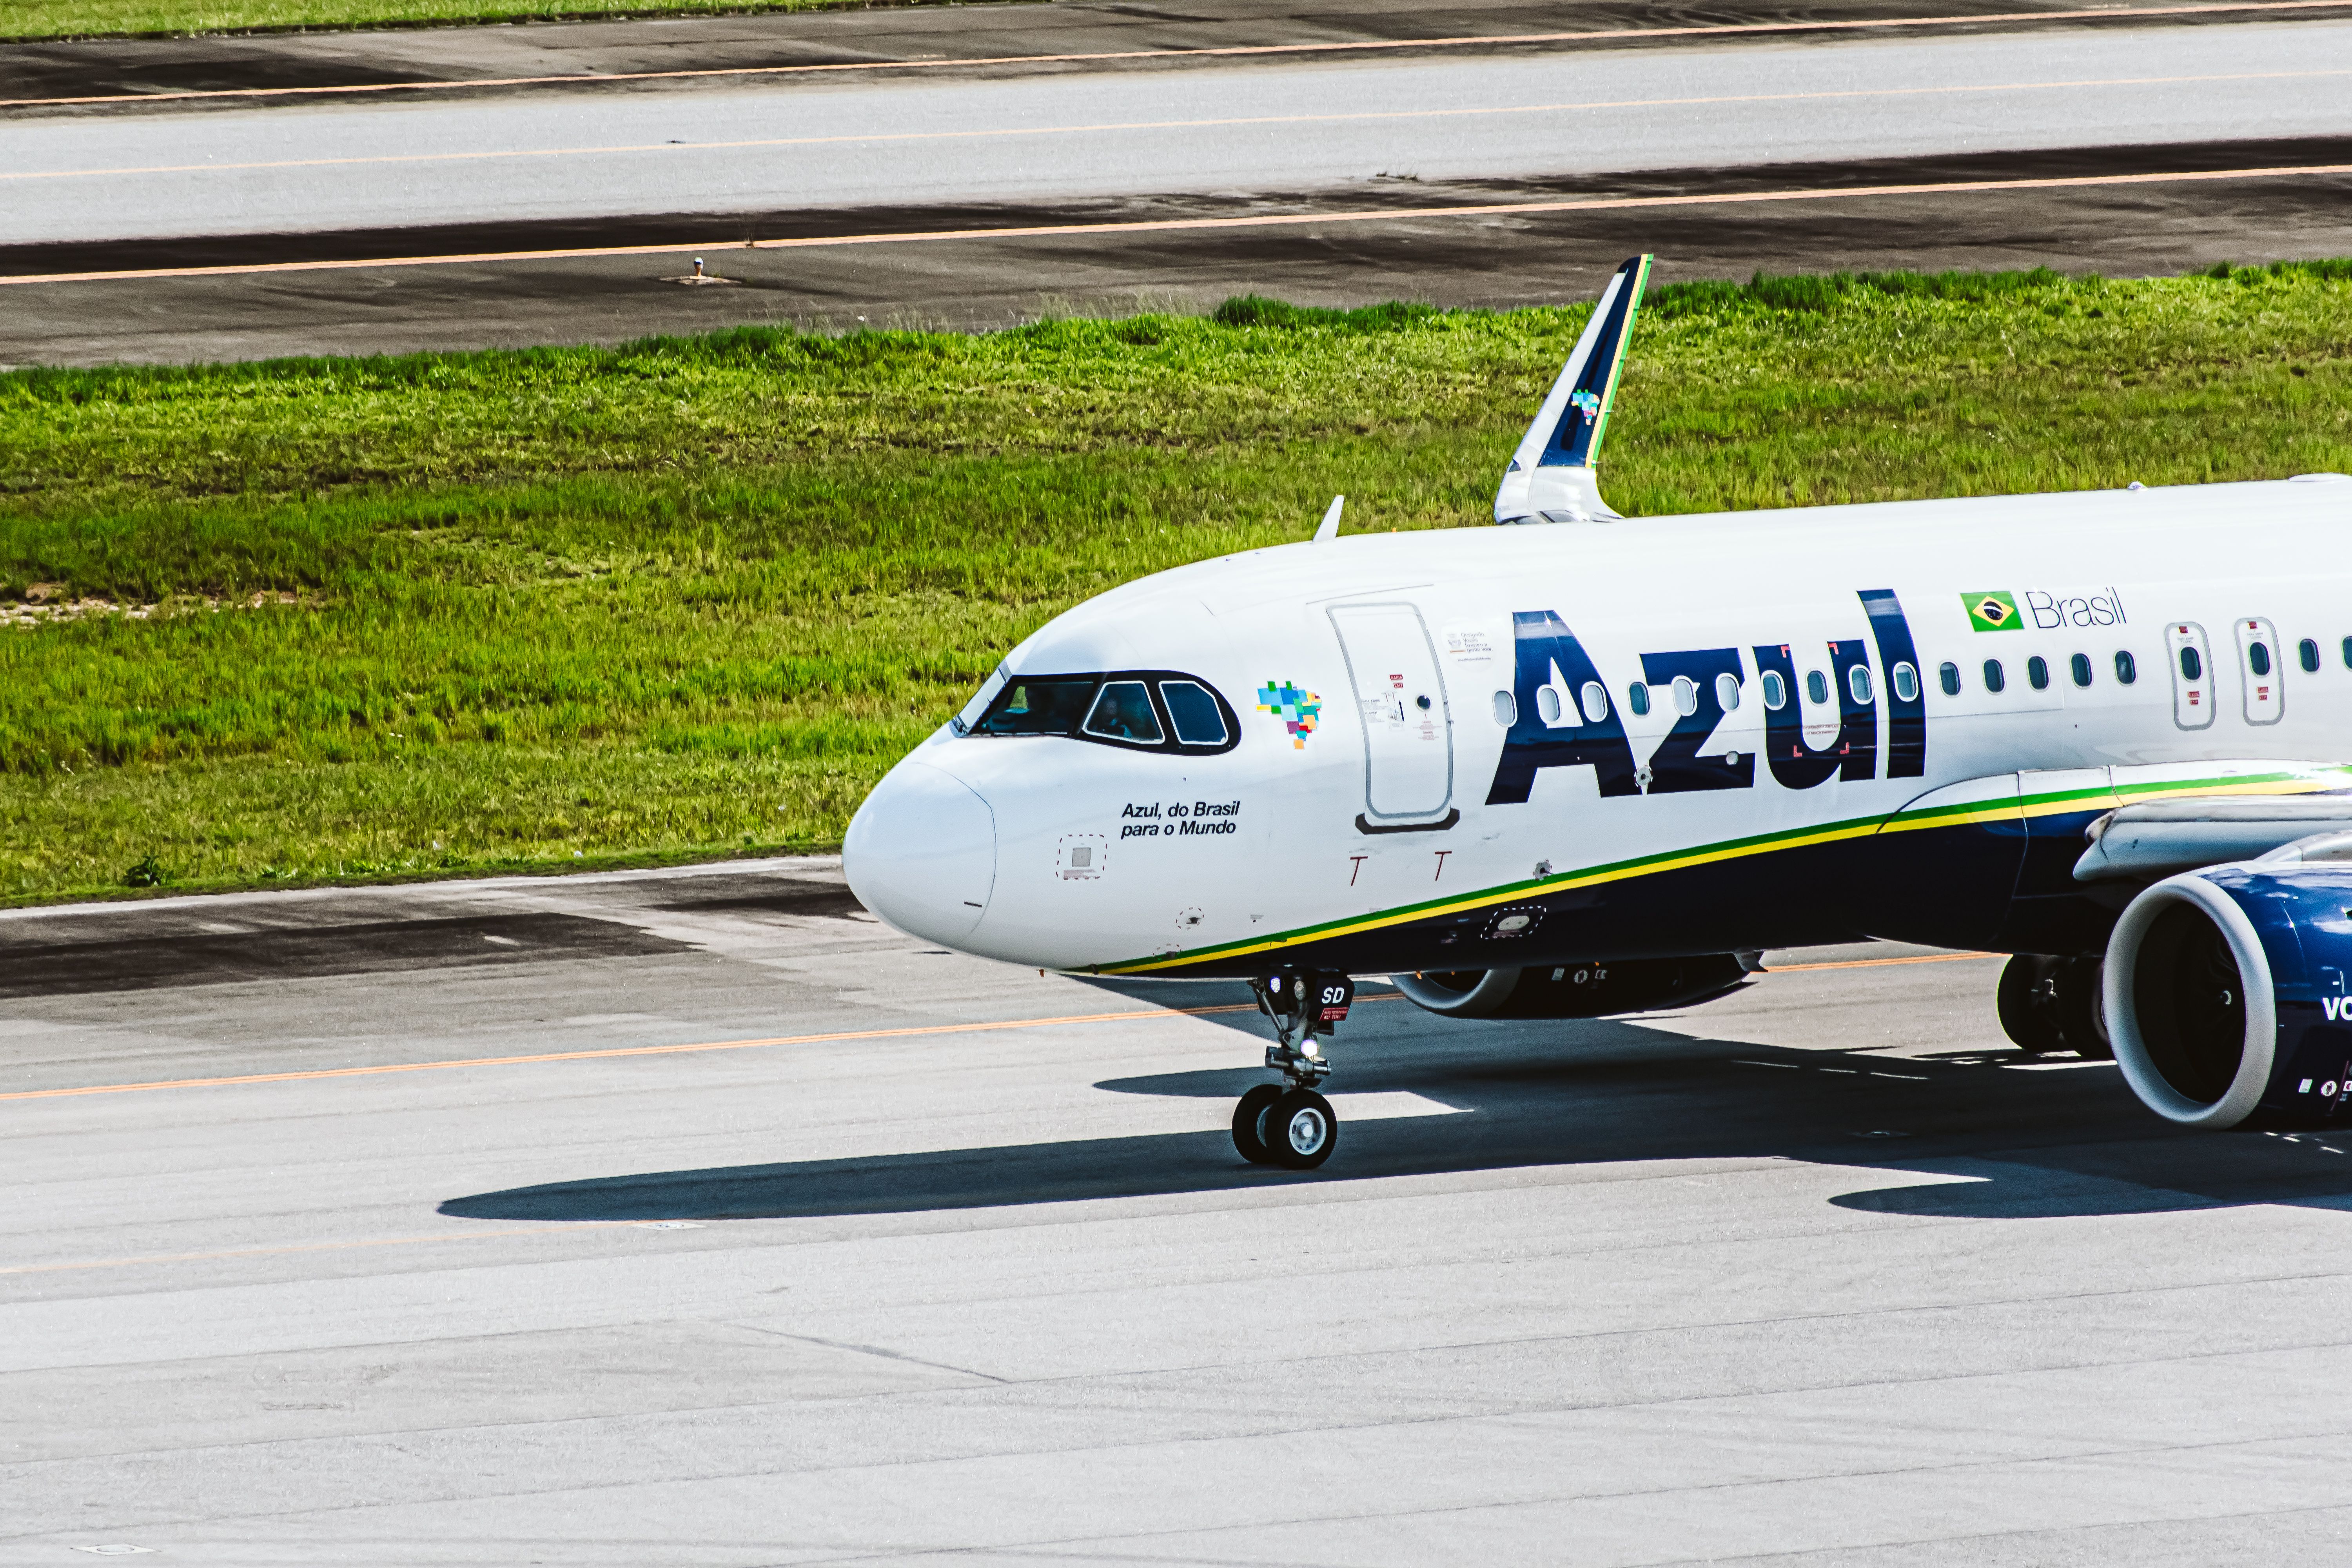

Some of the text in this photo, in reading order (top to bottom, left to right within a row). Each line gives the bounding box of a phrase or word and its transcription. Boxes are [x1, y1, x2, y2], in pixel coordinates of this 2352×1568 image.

[2025, 586, 2127, 628] Brasil
[1485, 588, 1927, 805] Azul
[1121, 801, 1240, 820] Azul, do Brasil
[1120, 819, 1236, 840] para o Mundo
[1322, 987, 1345, 1004] SD
